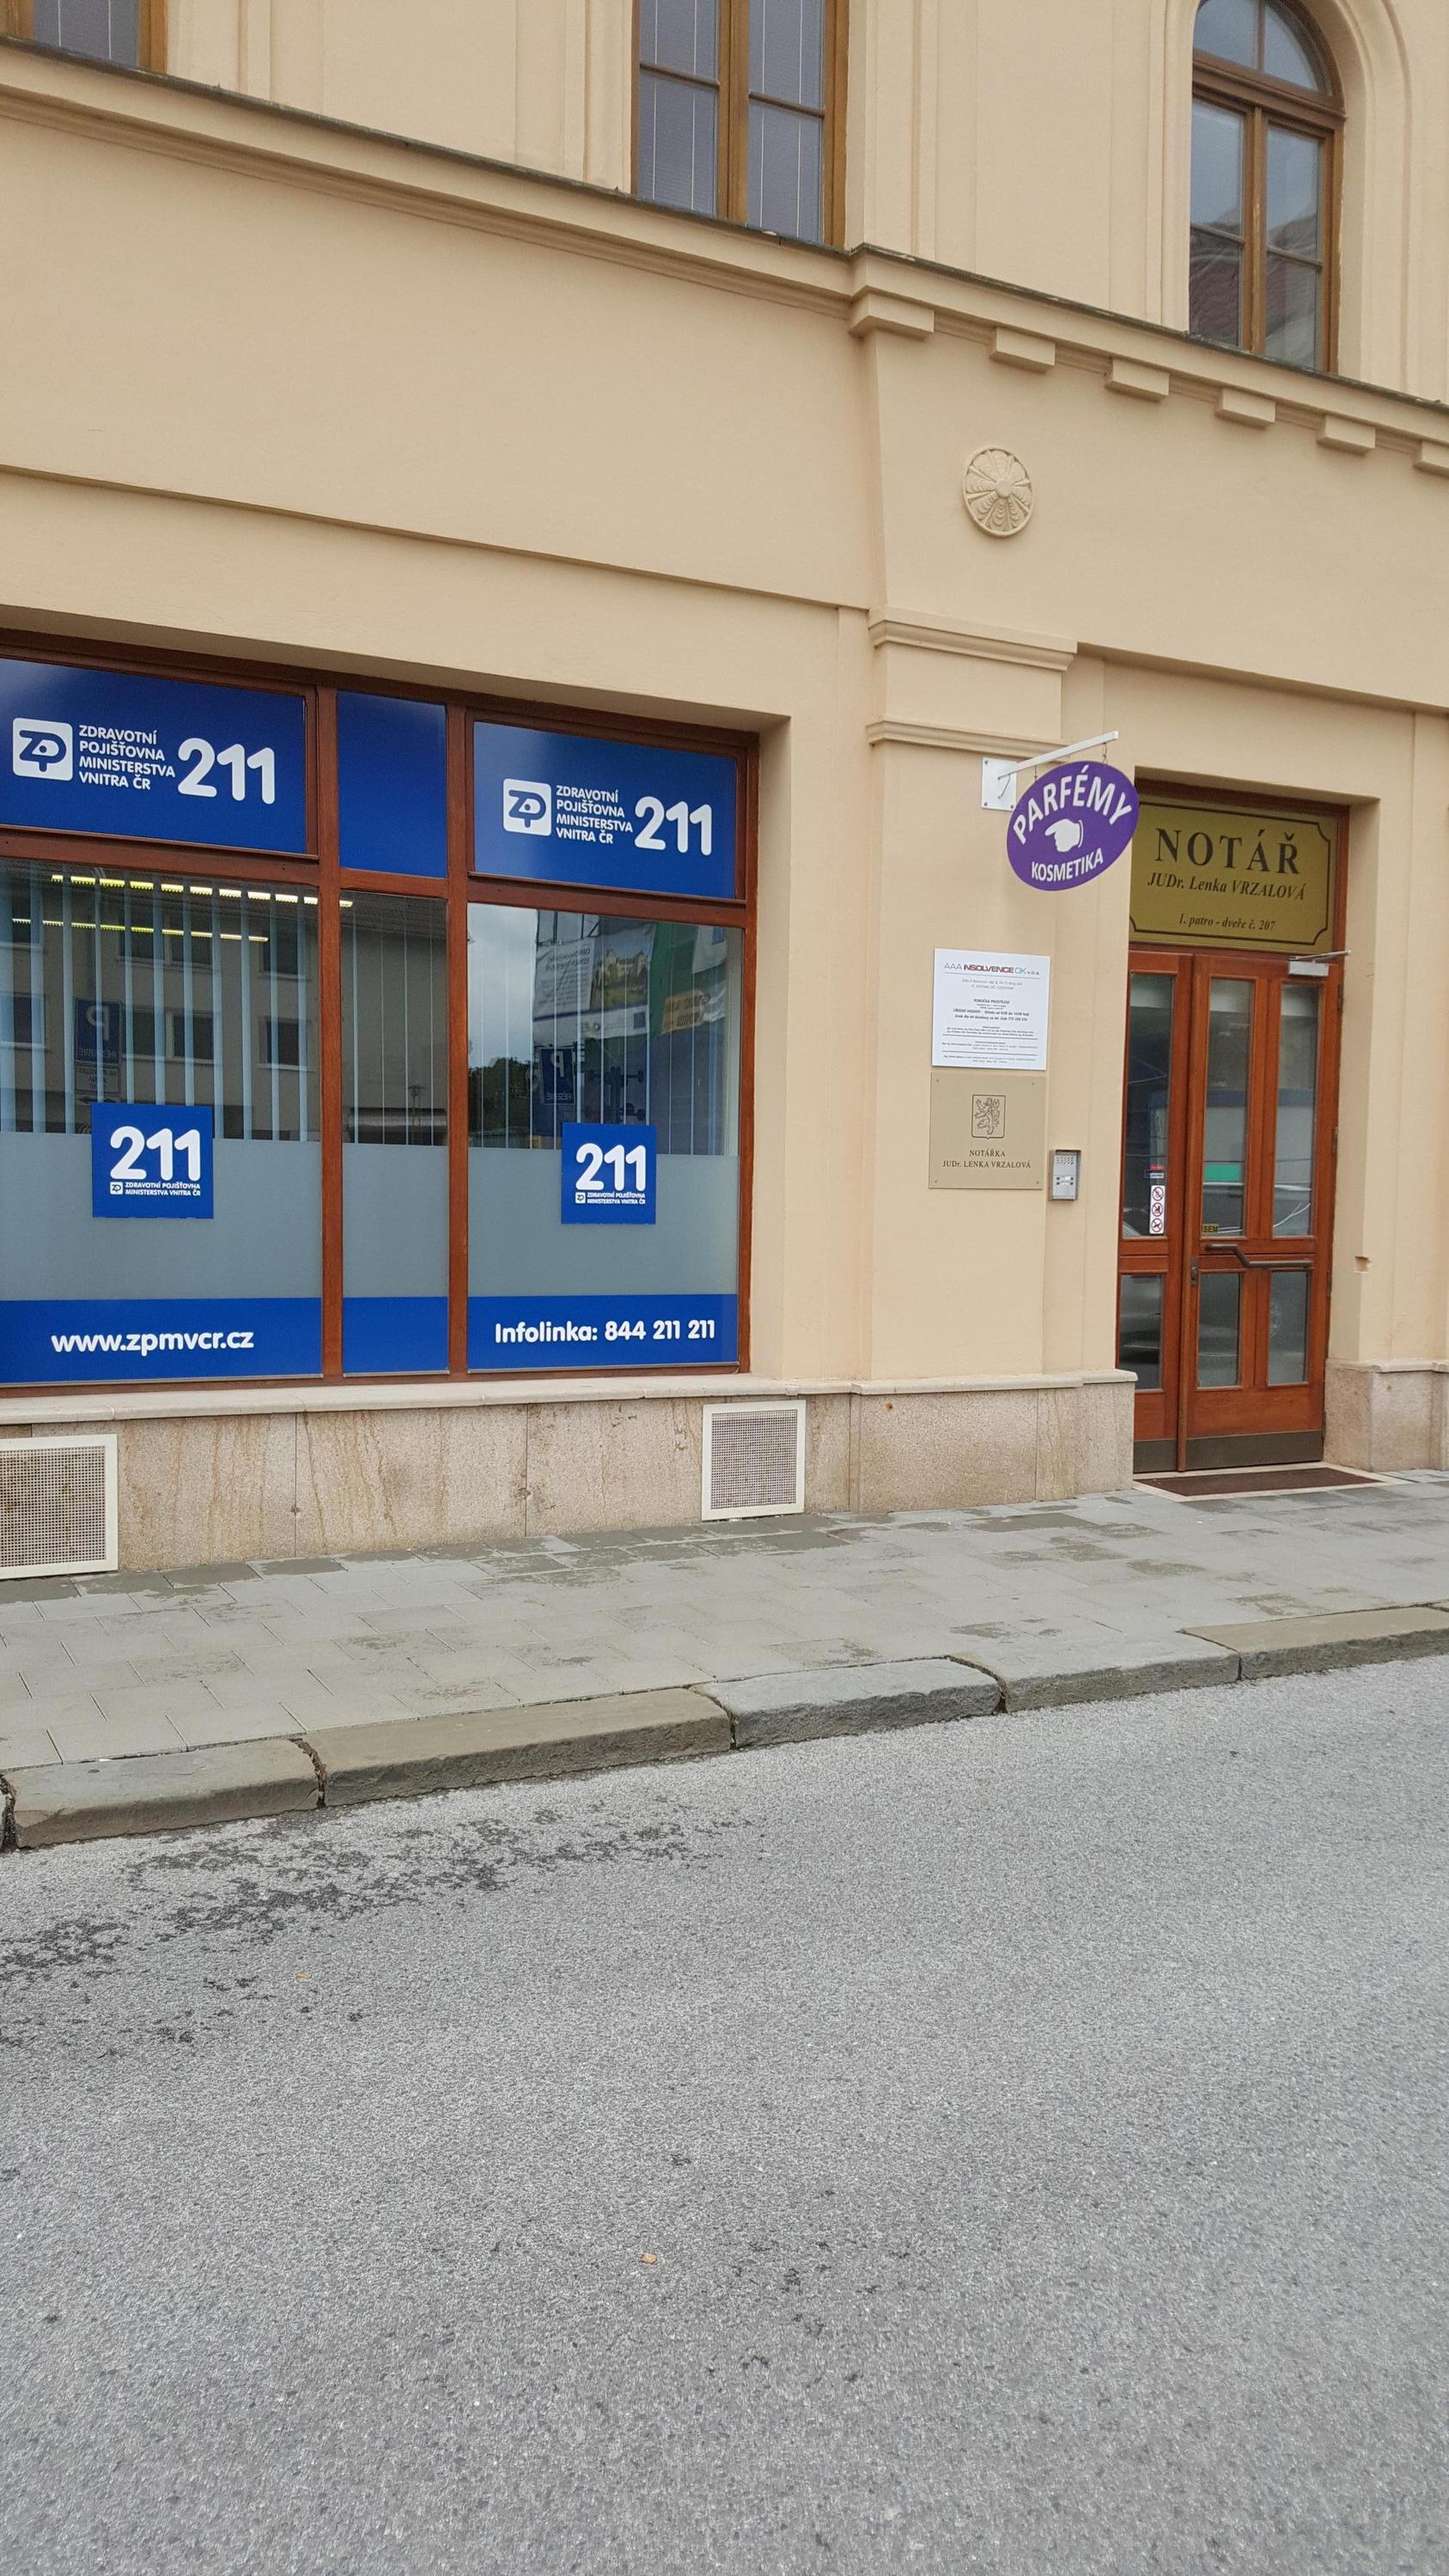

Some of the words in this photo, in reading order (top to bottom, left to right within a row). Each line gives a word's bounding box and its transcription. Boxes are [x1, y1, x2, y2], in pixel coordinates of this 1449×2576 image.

[79, 725, 157, 744] ZDRAVOTNÍ
[79, 740, 165, 761] POJIŠŤOVNA
[79, 756, 175, 777] MINISTERSTVA
[178, 738, 276, 805] 211
[79, 771, 129, 787] VNITRA
[132, 773, 151, 790] ČR
[556, 785, 619, 801] ZDRAVOTNÍ
[557, 798, 625, 818] POJIŠŤOVNA
[1013, 764, 1132, 845] PARFÉMY
[556, 813, 633, 833] MINISTERSTVA
[634, 796, 713, 856] 211
[556, 827, 595, 842] VNITRA
[599, 829, 613, 844] ČR
[1154, 827, 1300, 874] NOTÁŘ
[1031, 848, 1104, 882] KOSMETIKA
[1147, 872, 1184, 889] JUDr.
[1190, 876, 1227, 893] Lenka
[1232, 878, 1306, 901] VRZALOVÁ
[1178, 913, 1186, 925] 1.
[1189, 915, 1214, 928] patro
[1222, 917, 1246, 928] dveře
[1259, 920, 1276, 931] 207
[964, 963, 1014, 974] INSOLVENCE
[110, 1126, 201, 1182] 211
[969, 1149, 1006, 1157] NOTÁŘKA
[575, 1143, 646, 1191] 211
[992, 1160, 1032, 1169] VRZALOVÁ
[192, 1188, 201, 1196] ČR
[495, 1321, 598, 1343] Infolinka:
[605, 1321, 646, 1341] 844
[653, 1320, 681, 1340] 211
[687, 1319, 715, 1340] 211
[51, 1331, 254, 1357] www.zpmvcr.cz
